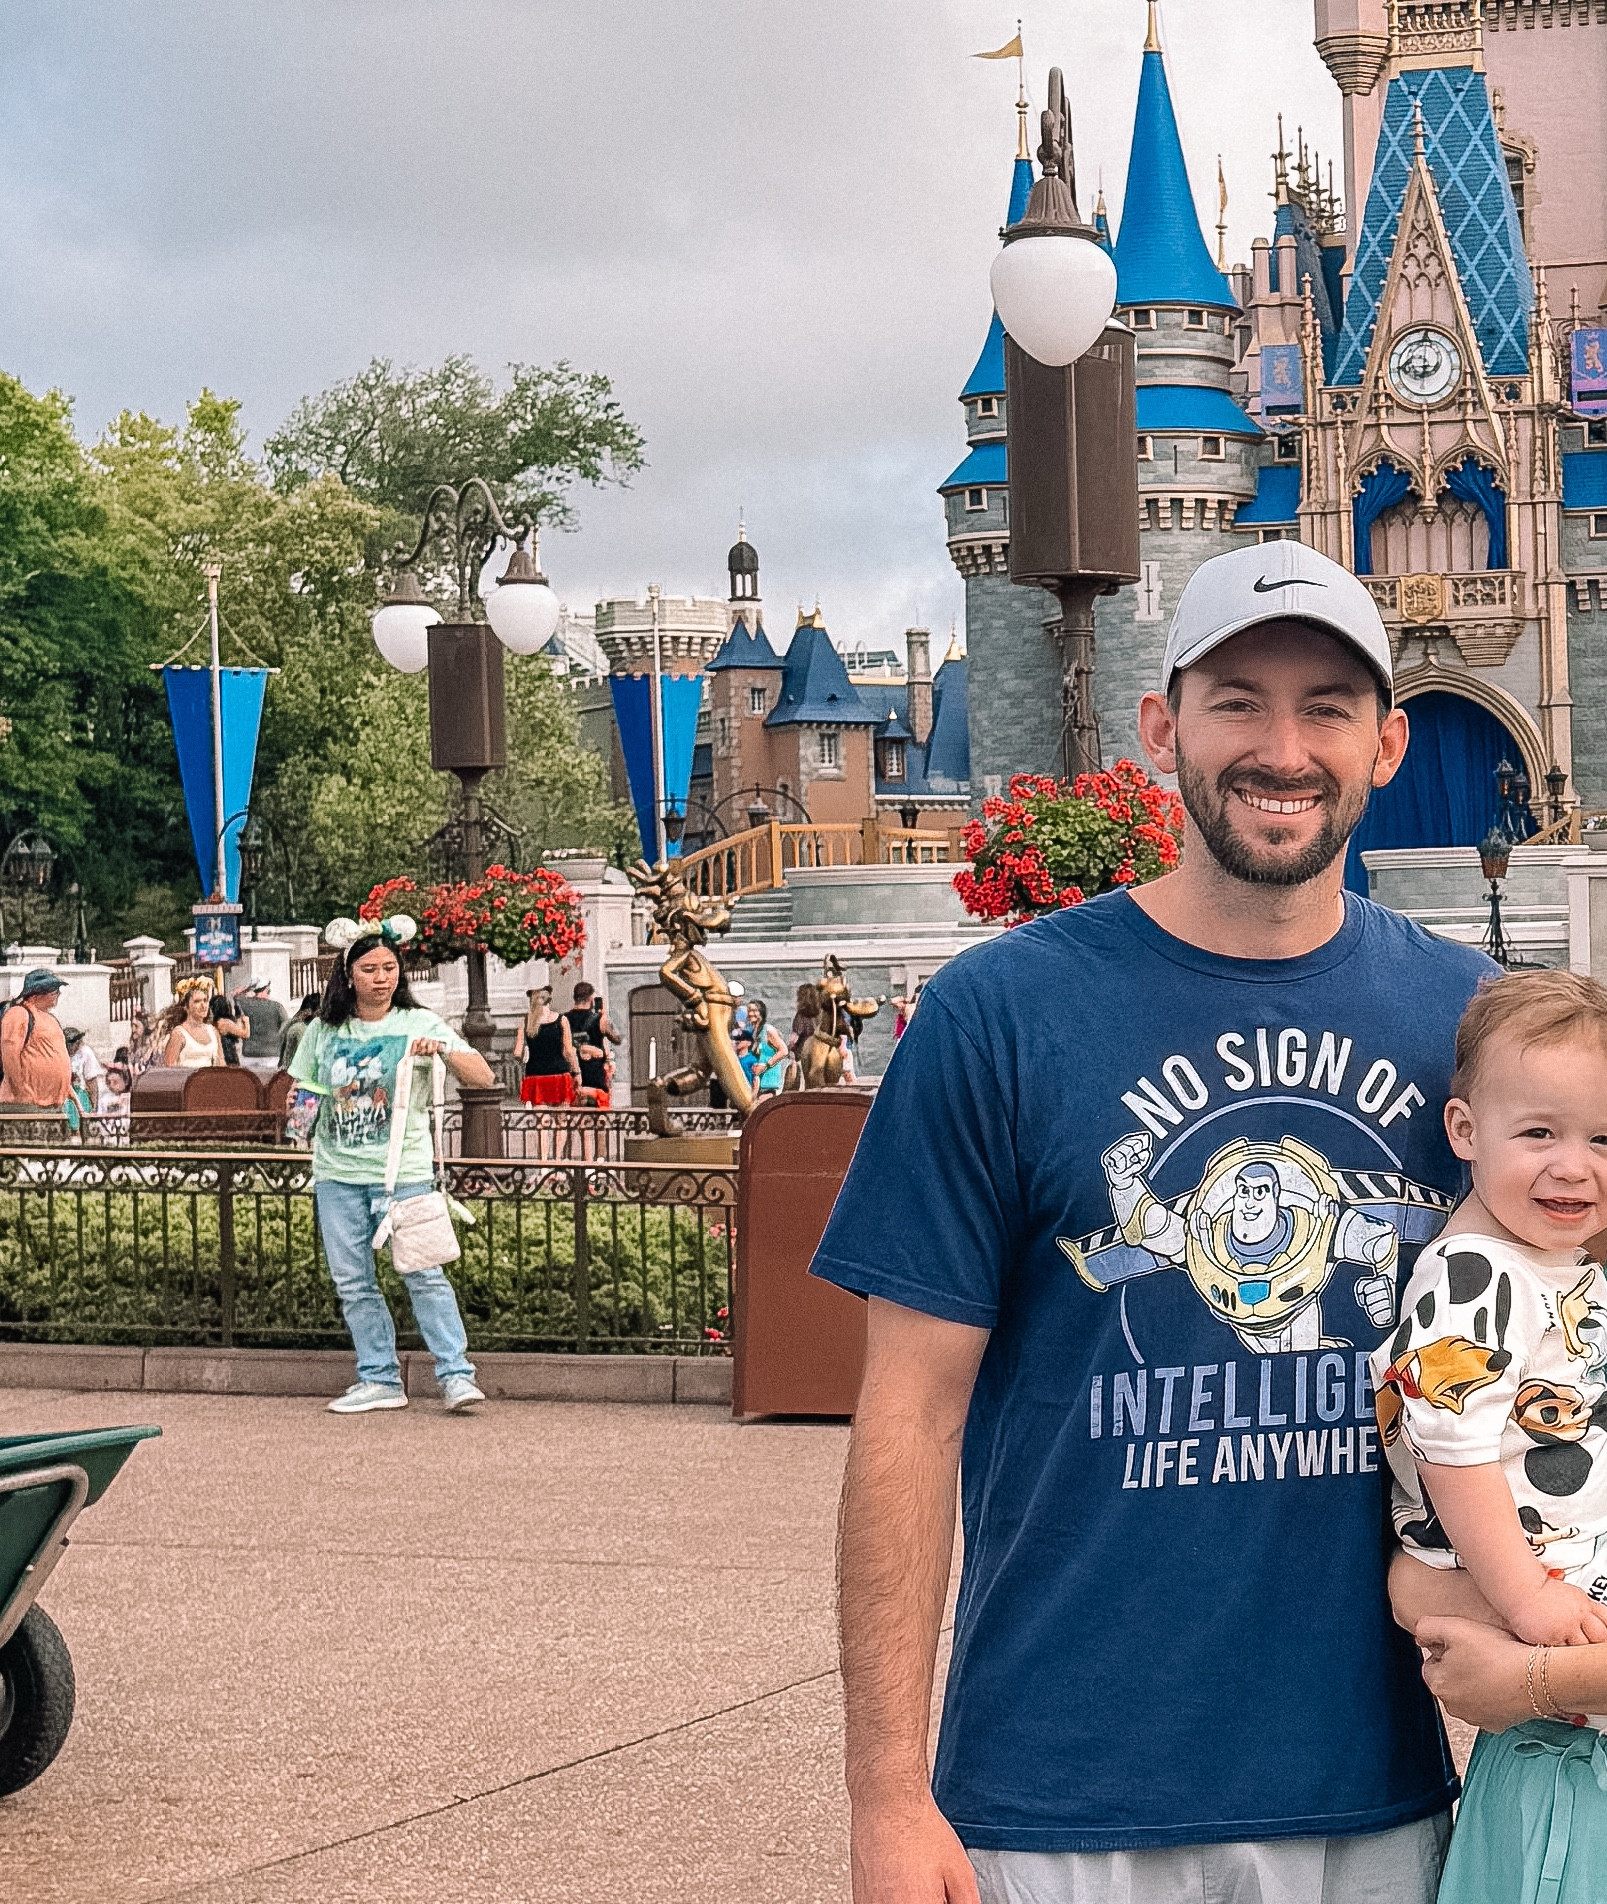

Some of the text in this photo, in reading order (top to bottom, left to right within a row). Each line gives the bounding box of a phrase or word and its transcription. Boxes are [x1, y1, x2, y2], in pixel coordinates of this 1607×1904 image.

[1120, 1027, 1427, 1140] NO SIGN OF
[1089, 1351, 1375, 1439] INTELLIGE
[1122, 1425, 1378, 1490] LIFE ANYWHE
